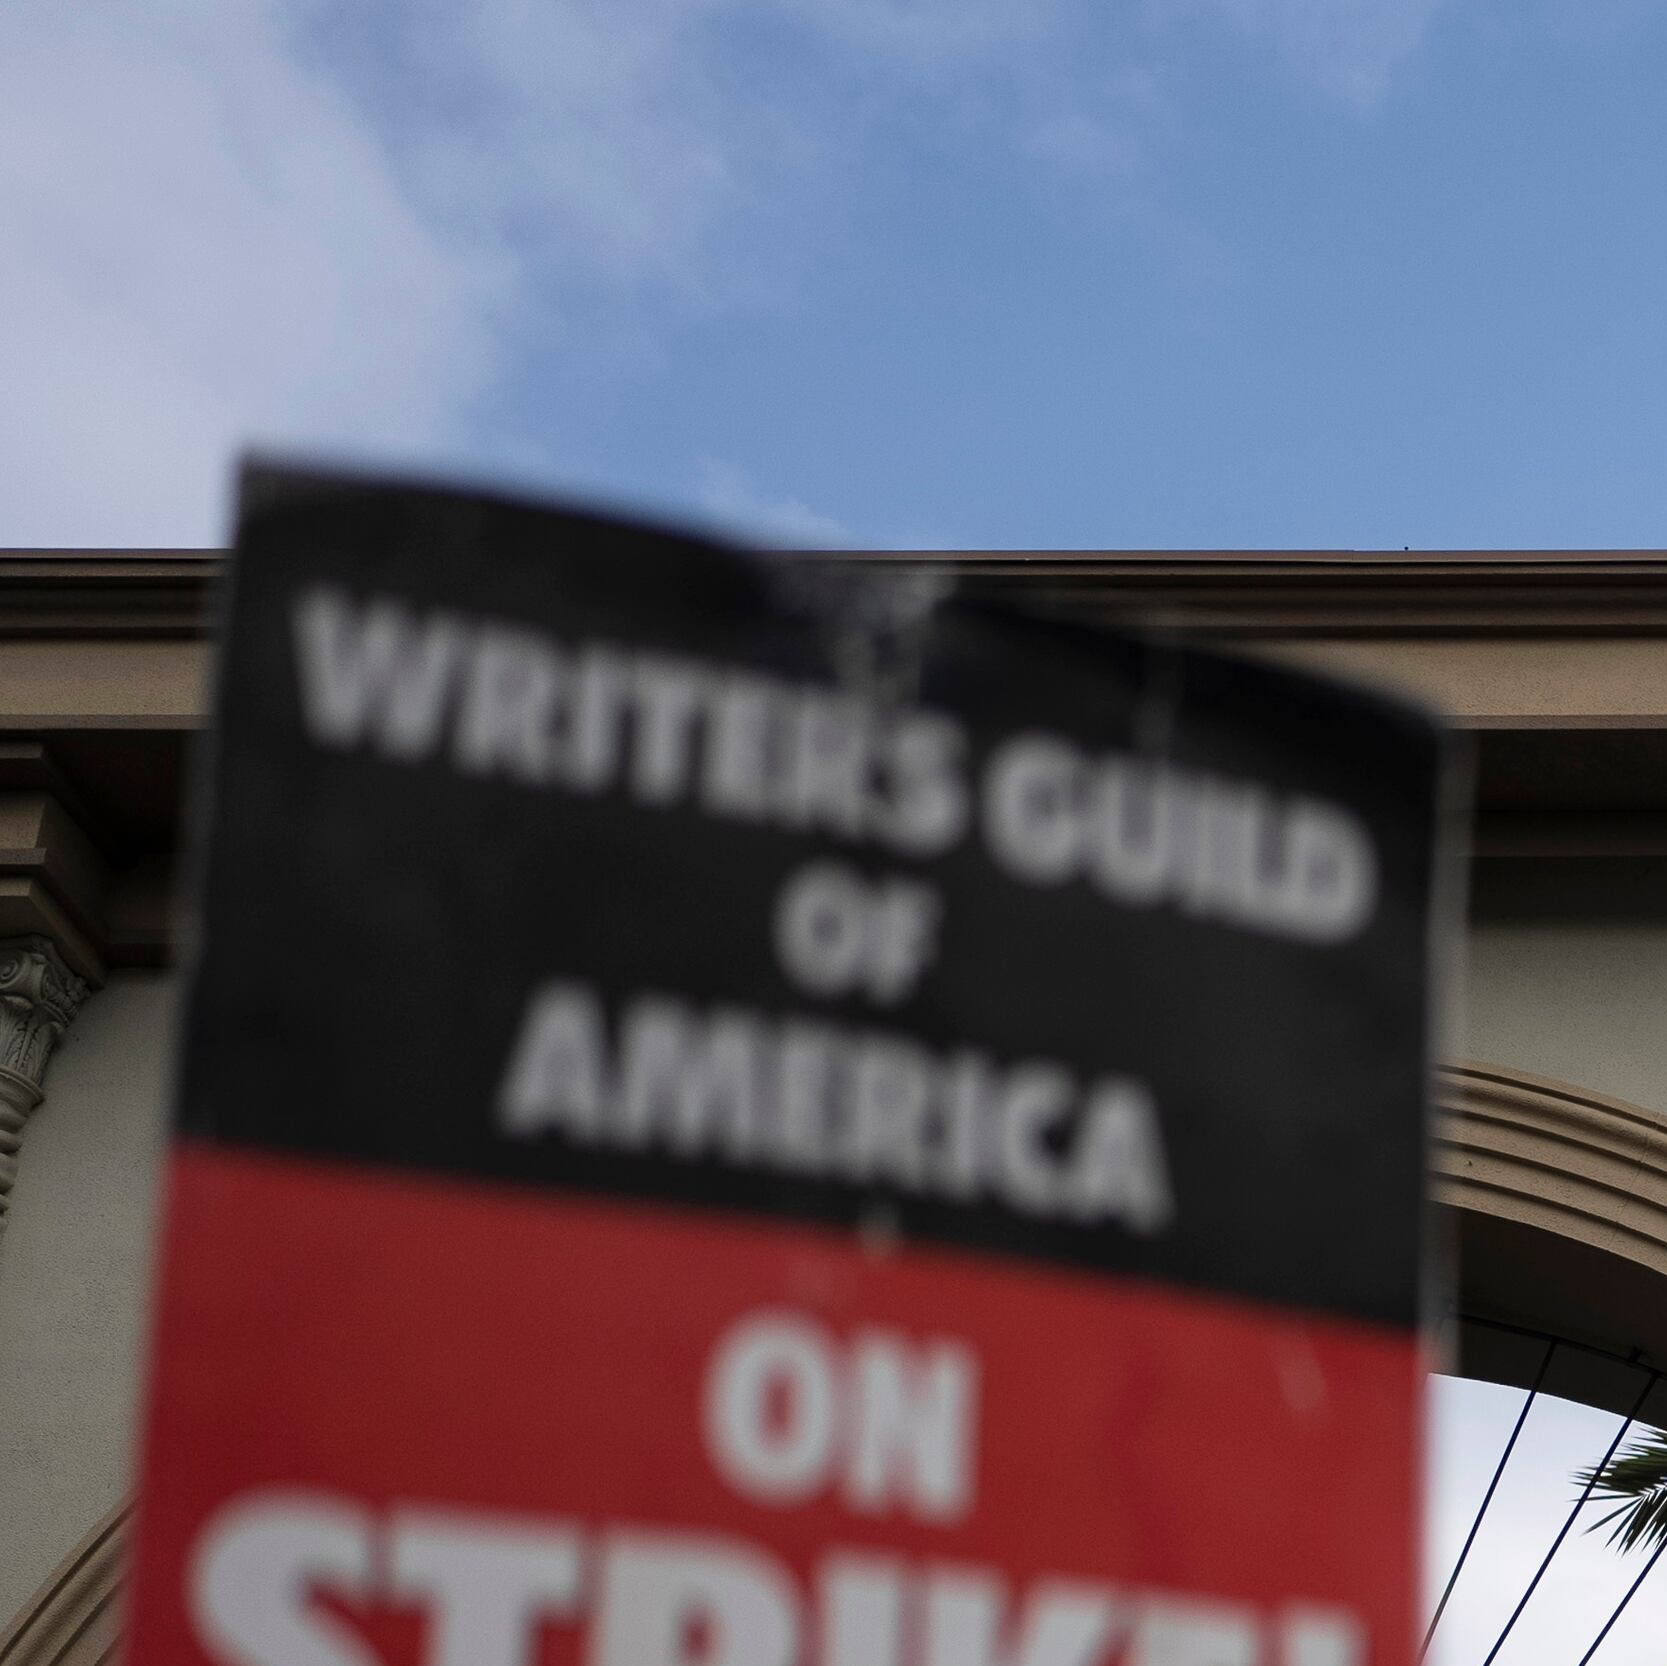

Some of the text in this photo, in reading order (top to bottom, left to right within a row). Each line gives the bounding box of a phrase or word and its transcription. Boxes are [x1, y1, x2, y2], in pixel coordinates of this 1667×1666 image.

[294, 590, 1377, 942] WRITERS GUILD
[779, 865, 938, 1001] OF
[505, 994, 1173, 1231] AMERICA
[705, 1313, 975, 1516] ON
